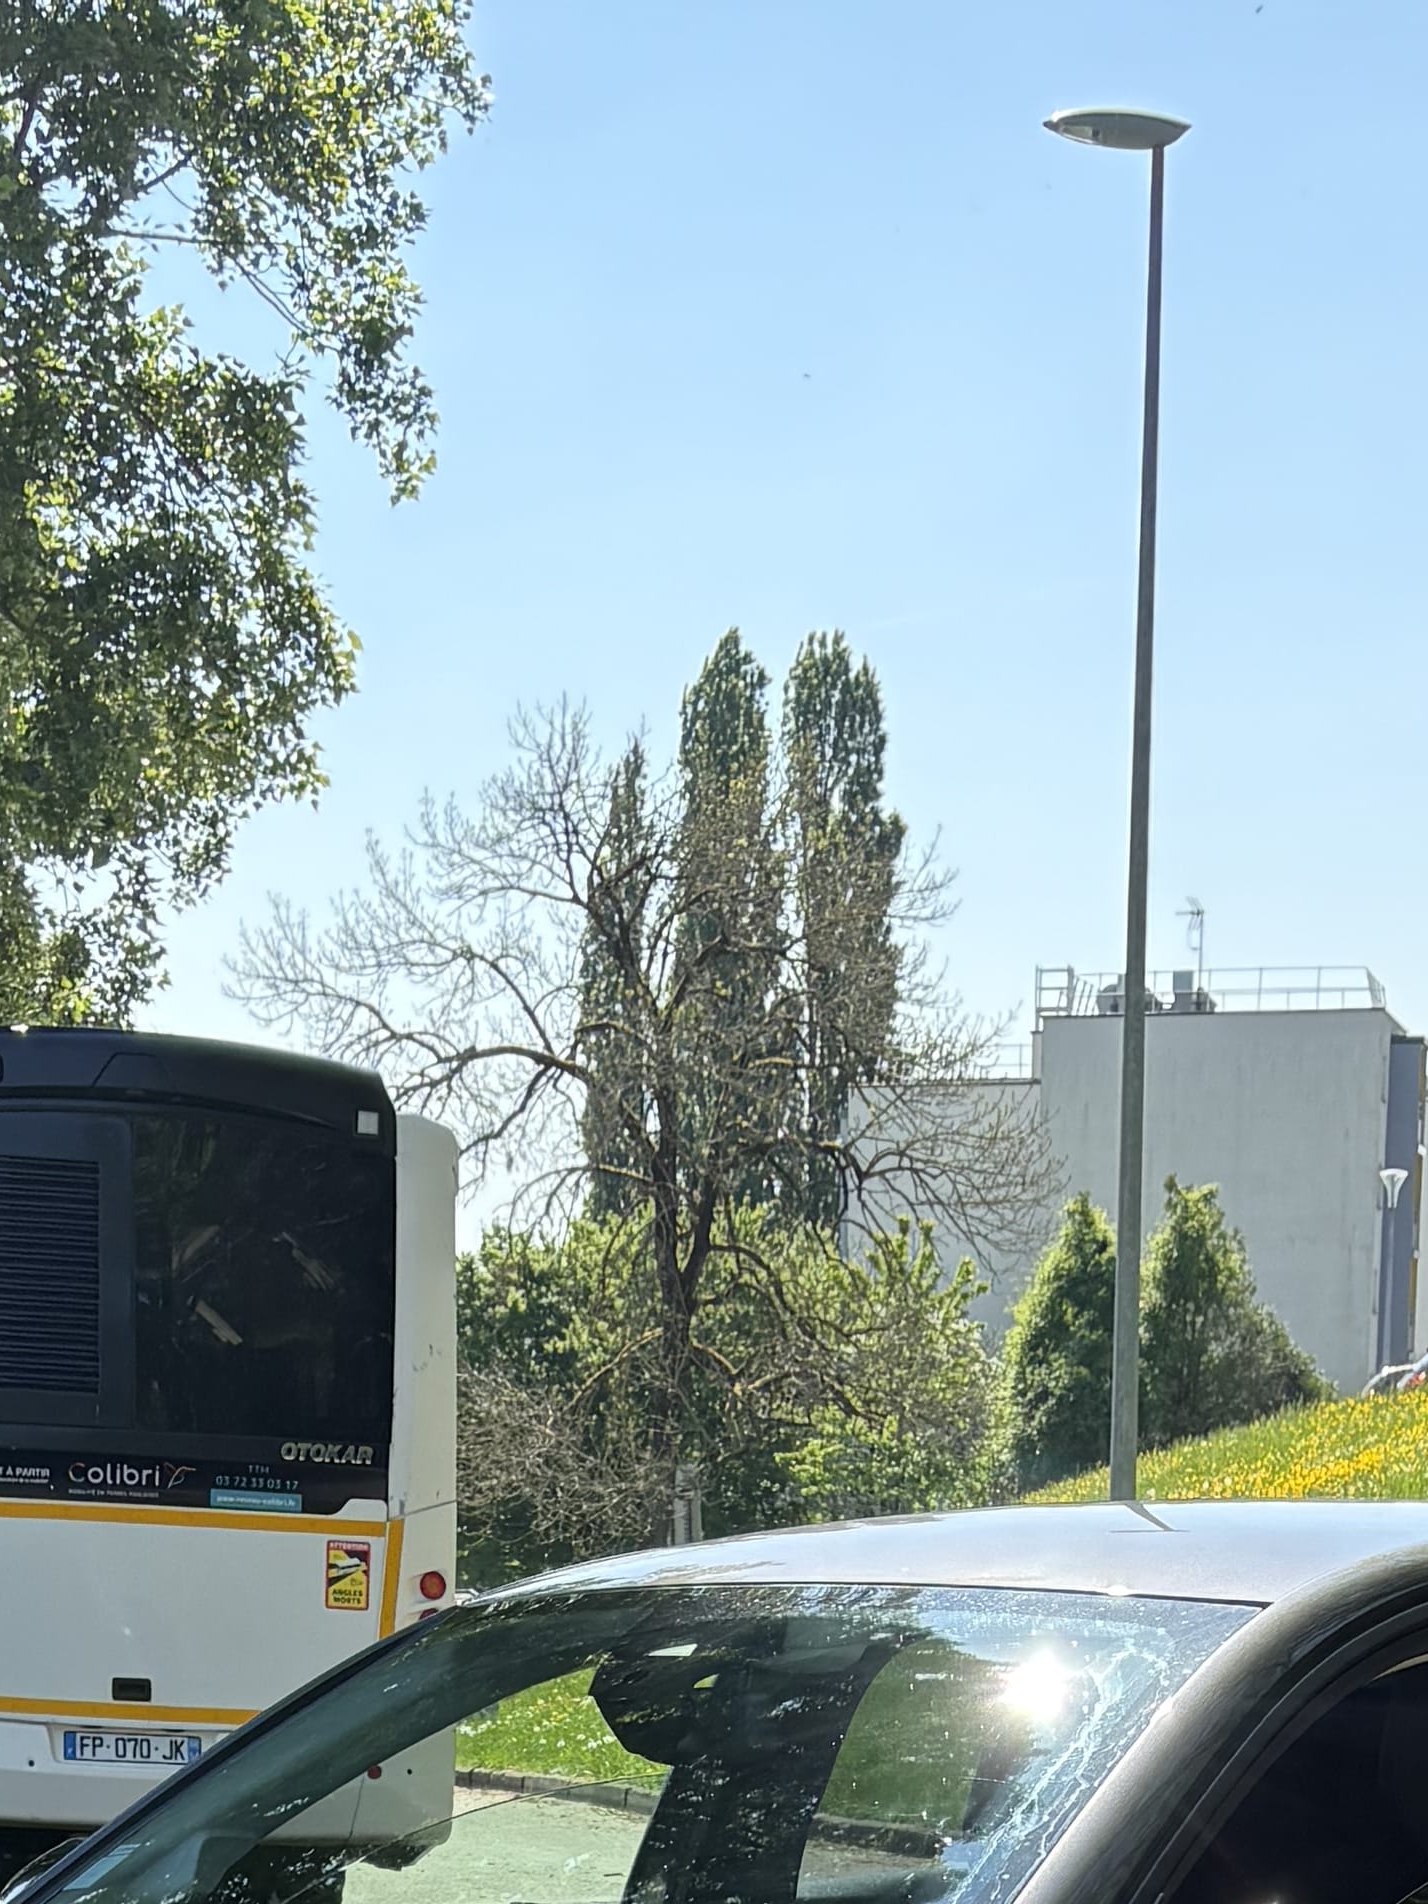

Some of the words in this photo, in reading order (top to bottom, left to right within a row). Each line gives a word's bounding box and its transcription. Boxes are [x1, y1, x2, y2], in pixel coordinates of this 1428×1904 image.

[280, 1442, 374, 1465] OTOKAR
[68, 1462, 160, 1487] Colibri
[215, 1475, 230, 1486] 03
[233, 1476, 247, 1487] 72
[286, 1480, 299, 1490] 17
